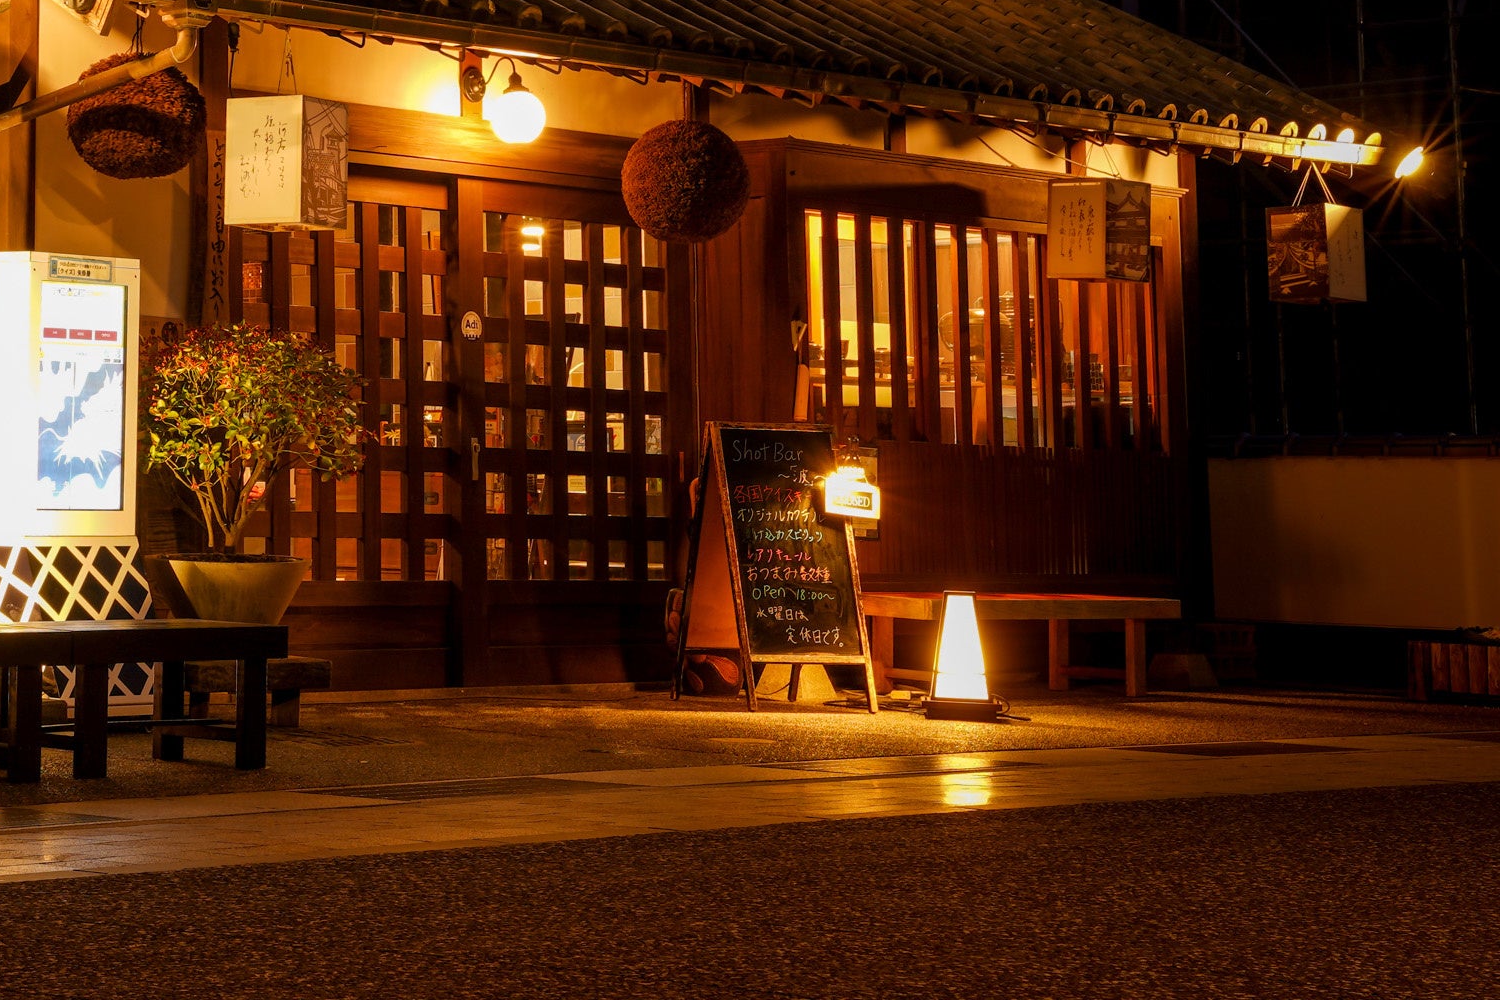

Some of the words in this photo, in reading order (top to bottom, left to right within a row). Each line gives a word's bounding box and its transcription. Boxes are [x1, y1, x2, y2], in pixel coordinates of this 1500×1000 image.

[732, 438, 770, 462] Shot
[773, 442, 803, 462] Bar
[756, 605, 809, 621] 水曜日は
[785, 625, 844, 648] 定休日です。
